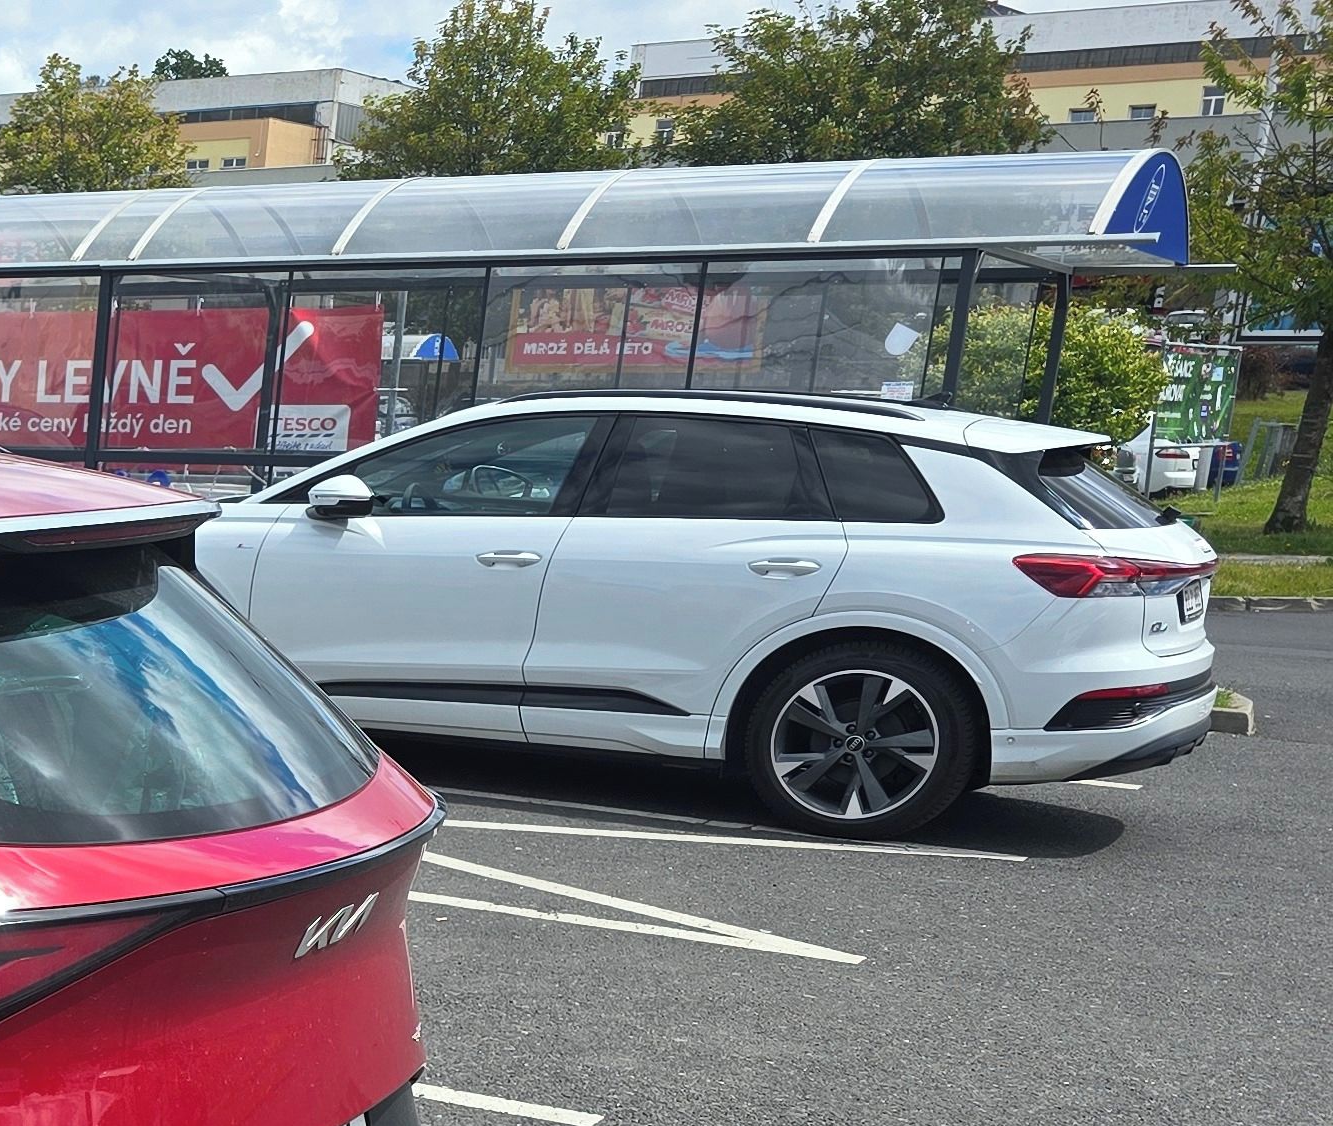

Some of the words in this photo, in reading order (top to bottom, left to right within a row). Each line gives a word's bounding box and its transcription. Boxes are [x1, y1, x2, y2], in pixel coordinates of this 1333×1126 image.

[523, 339, 567, 355] MROŽ
[573, 338, 611, 355] DĚLÁ
[27, 416, 77, 438] ceny
[149, 413, 192, 434] den
[294, 892, 380, 959] KIA
